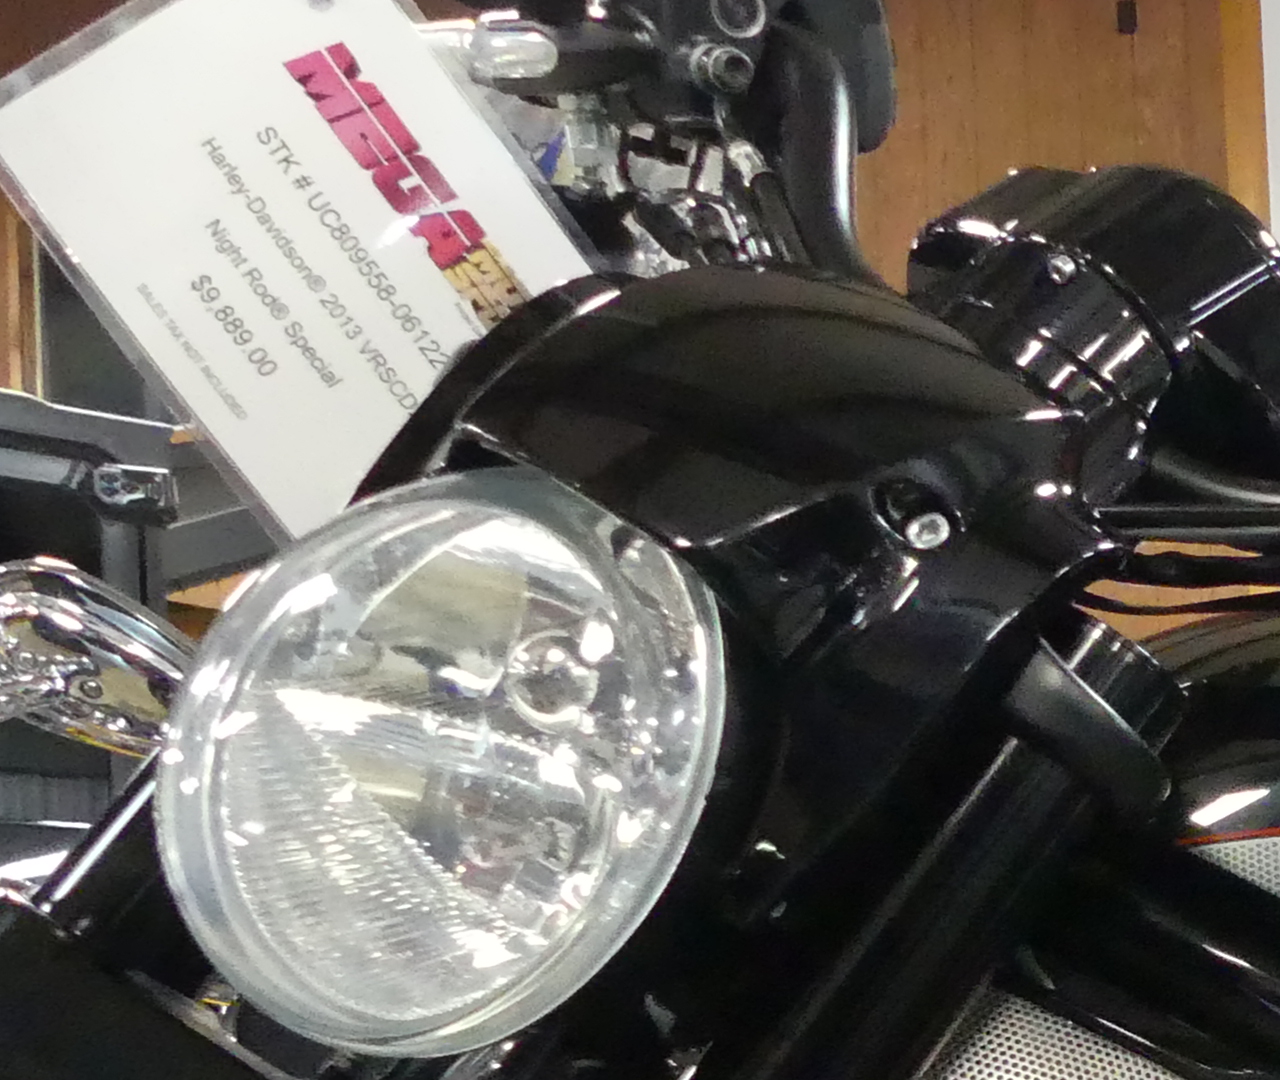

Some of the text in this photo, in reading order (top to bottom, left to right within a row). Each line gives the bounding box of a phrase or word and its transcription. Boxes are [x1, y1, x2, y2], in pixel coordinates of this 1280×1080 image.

[256, 126, 302, 176] STK
[292, 174, 315, 191] #
[191, 274, 278, 377] $9,889.00
[205, 218, 248, 269] Night
[284, 321, 343, 388] Special
[319, 293, 363, 340] 2013
[359, 338, 419, 416] VRSCD
